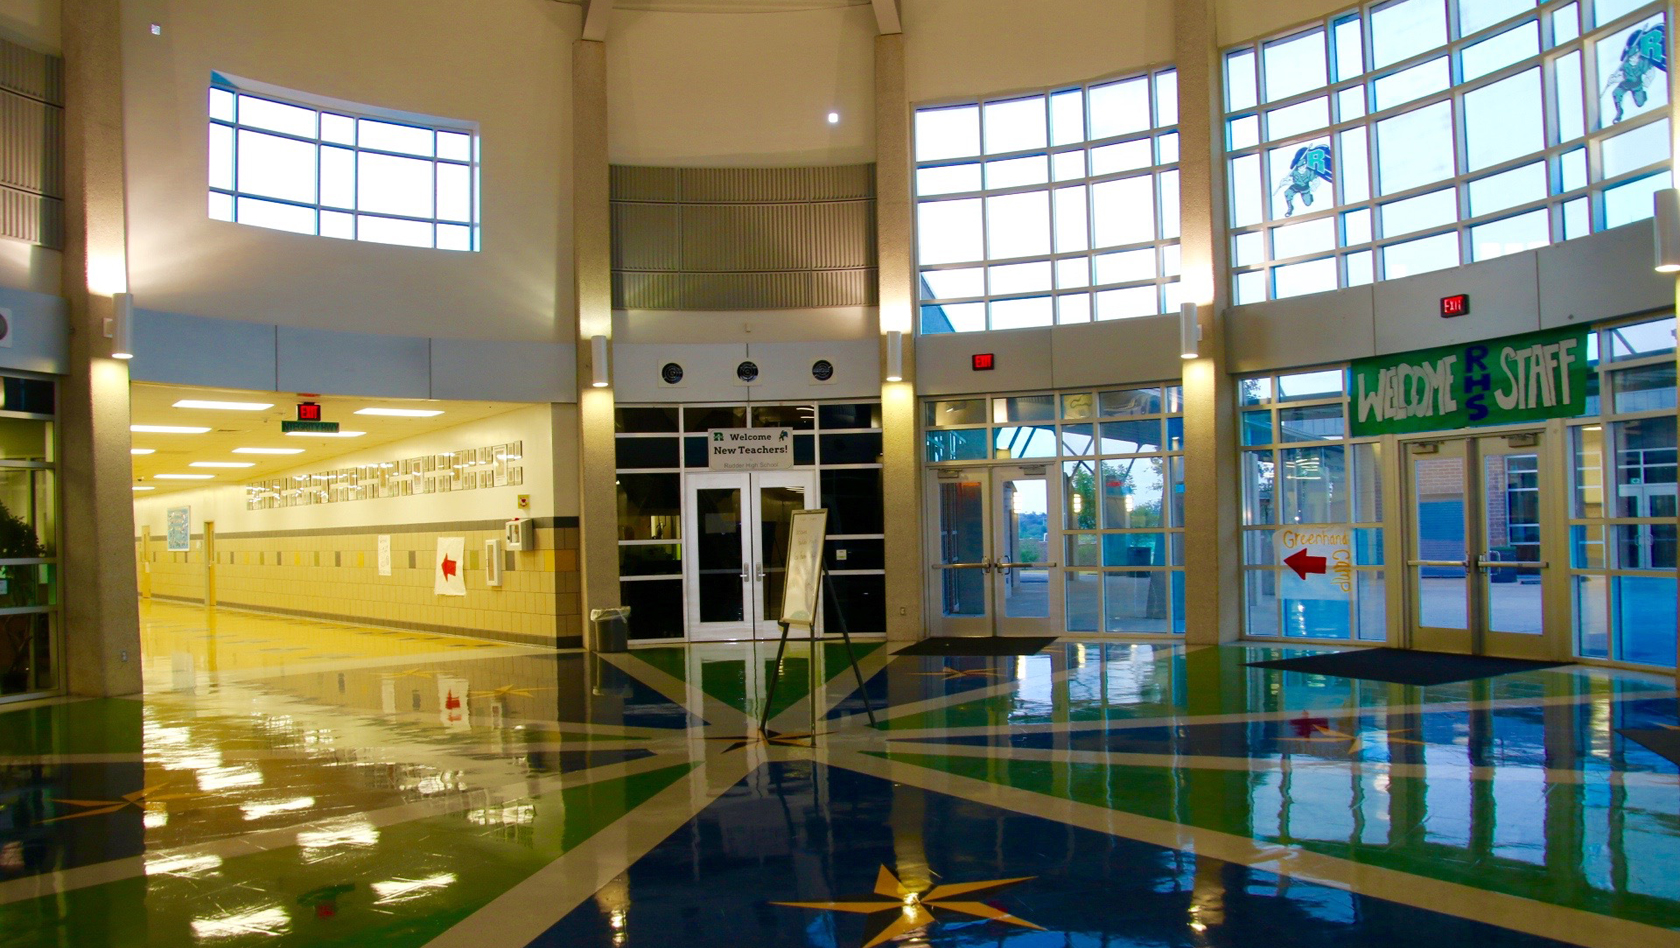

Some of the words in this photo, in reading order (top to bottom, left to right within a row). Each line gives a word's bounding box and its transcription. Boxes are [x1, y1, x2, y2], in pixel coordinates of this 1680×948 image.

[1640, 29, 1664, 62] R
[1307, 149, 1326, 174] R
[1444, 297, 1462, 313] EXIT
[974, 355, 992, 368] EXIT
[1358, 355, 1458, 423] WELCOME
[1464, 345, 1491, 421] RHS
[1494, 338, 1578, 410] STAFF
[300, 405, 318, 419] EXIT
[730, 433, 772, 441] Welcome
[714, 446, 737, 455] New
[738, 445, 788, 454] Teachers!
